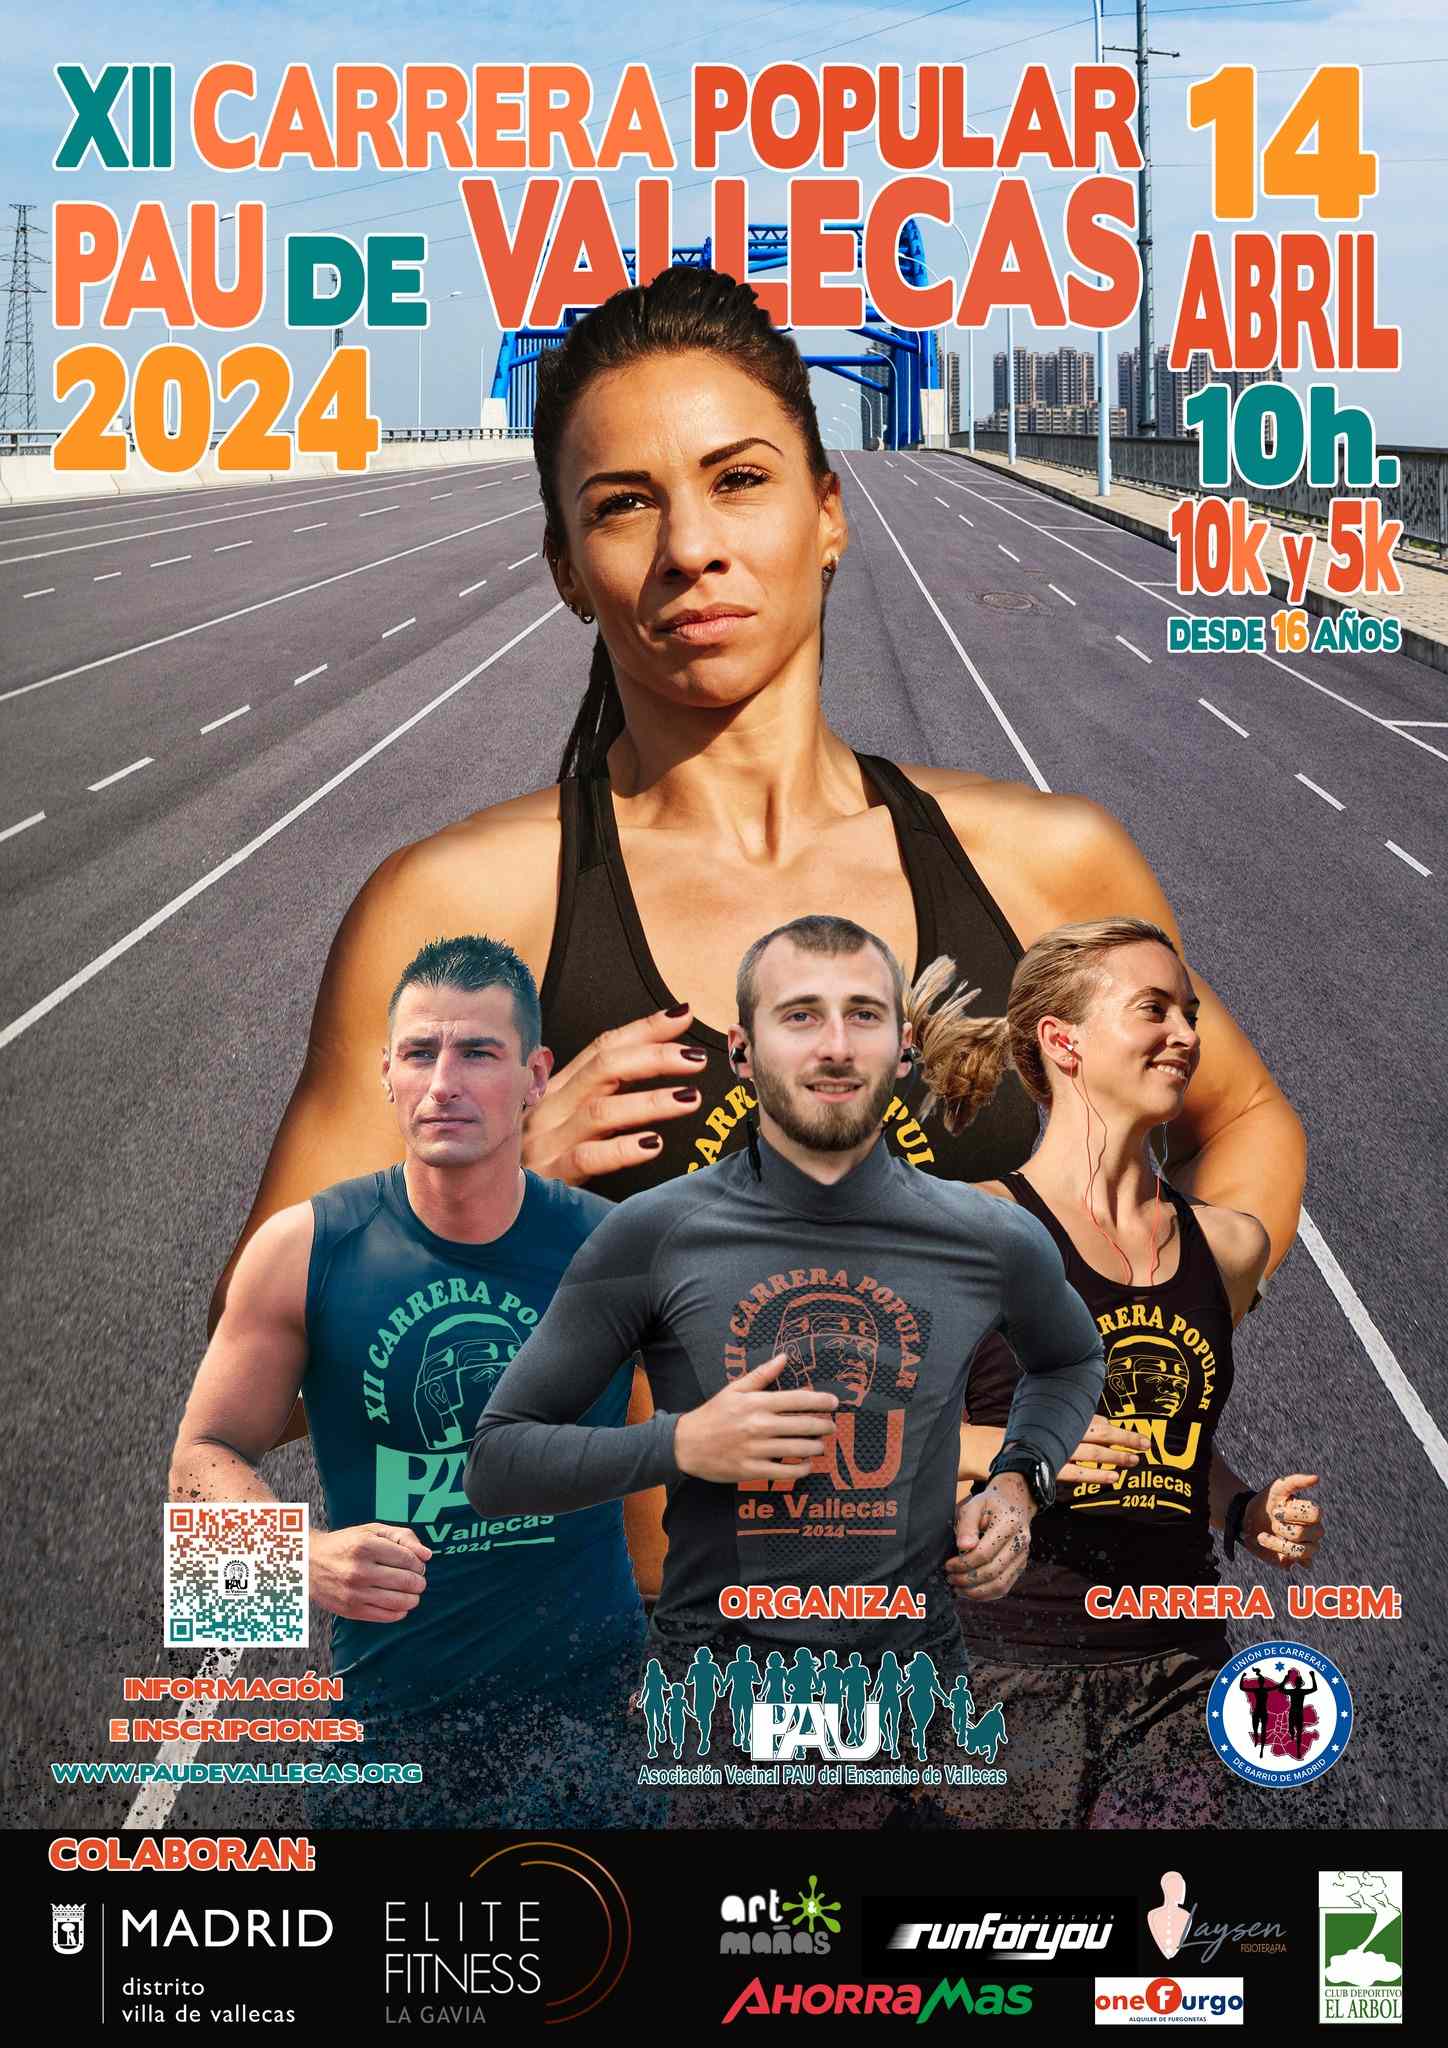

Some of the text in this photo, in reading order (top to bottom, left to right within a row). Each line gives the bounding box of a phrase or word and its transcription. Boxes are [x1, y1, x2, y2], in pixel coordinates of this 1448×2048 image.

[53, 60, 1145, 172] XII CARRERA POPULAR
[1187, 62, 1379, 222] 14
[52, 201, 266, 331] PAU
[284, 232, 430, 329] DE
[1167, 230, 1400, 372] ABRIL
[50, 342, 381, 475] 2024
[1184, 383, 1400, 489] 10h.
[1169, 496, 1403, 605] 10k y 5k
[1168, 608, 1402, 654] DESDE 16 AÑOS
[368, 1278, 491, 1369] CARRERA
[729, 1268, 849, 1337] CARRERA
[856, 1275, 921, 1389] POPULAR
[1169, 1314, 1216, 1410] POPULAR
[363, 1370, 390, 1424] XII
[1073, 1470, 1192, 1497] de Vallecas
[738, 1494, 897, 1520] de Vallecas
[1121, 1494, 1156, 1509] 2024
[444, 1540, 493, 1555] 2024
[802, 1524, 847, 1538] 2024
[719, 1585, 926, 1620] ORGANIZA:
[1085, 1585, 1402, 1619] CARRERA UCBM:
[1232, 1647, 1327, 1672] UNIÓN DE CARRERAS
[124, 1670, 343, 1701] INFORMACIÓN
[109, 1718, 364, 1743] E INSCRIPCIONES:
[751, 1701, 881, 1761] PAU
[51, 1763, 422, 1784] WWW.PAUDEVALLECAS.ORG
[638, 1763, 1007, 1785] Asociación Vecinal PAU del Ensanche de Vallecas
[1233, 1758, 1326, 1782] DE BARRIO DE MADRID
[49, 1838, 315, 1871] COLABORAN:
[385, 1901, 540, 1942] ELITE
[721, 1889, 783, 1923] art
[121, 1909, 333, 1947] MADRID
[1176, 1903, 1287, 1963] Laysen
[122, 1977, 205, 1996] distrito
[385, 1953, 541, 1994] FITNESS
[1324, 1989, 1402, 1998] CLUB DEPORTIVO
[1326, 1999, 1402, 2019] EL ARBOL
[122, 2004, 295, 2023] villa de vallecas
[385, 2006, 486, 2024] LA GAVIA
